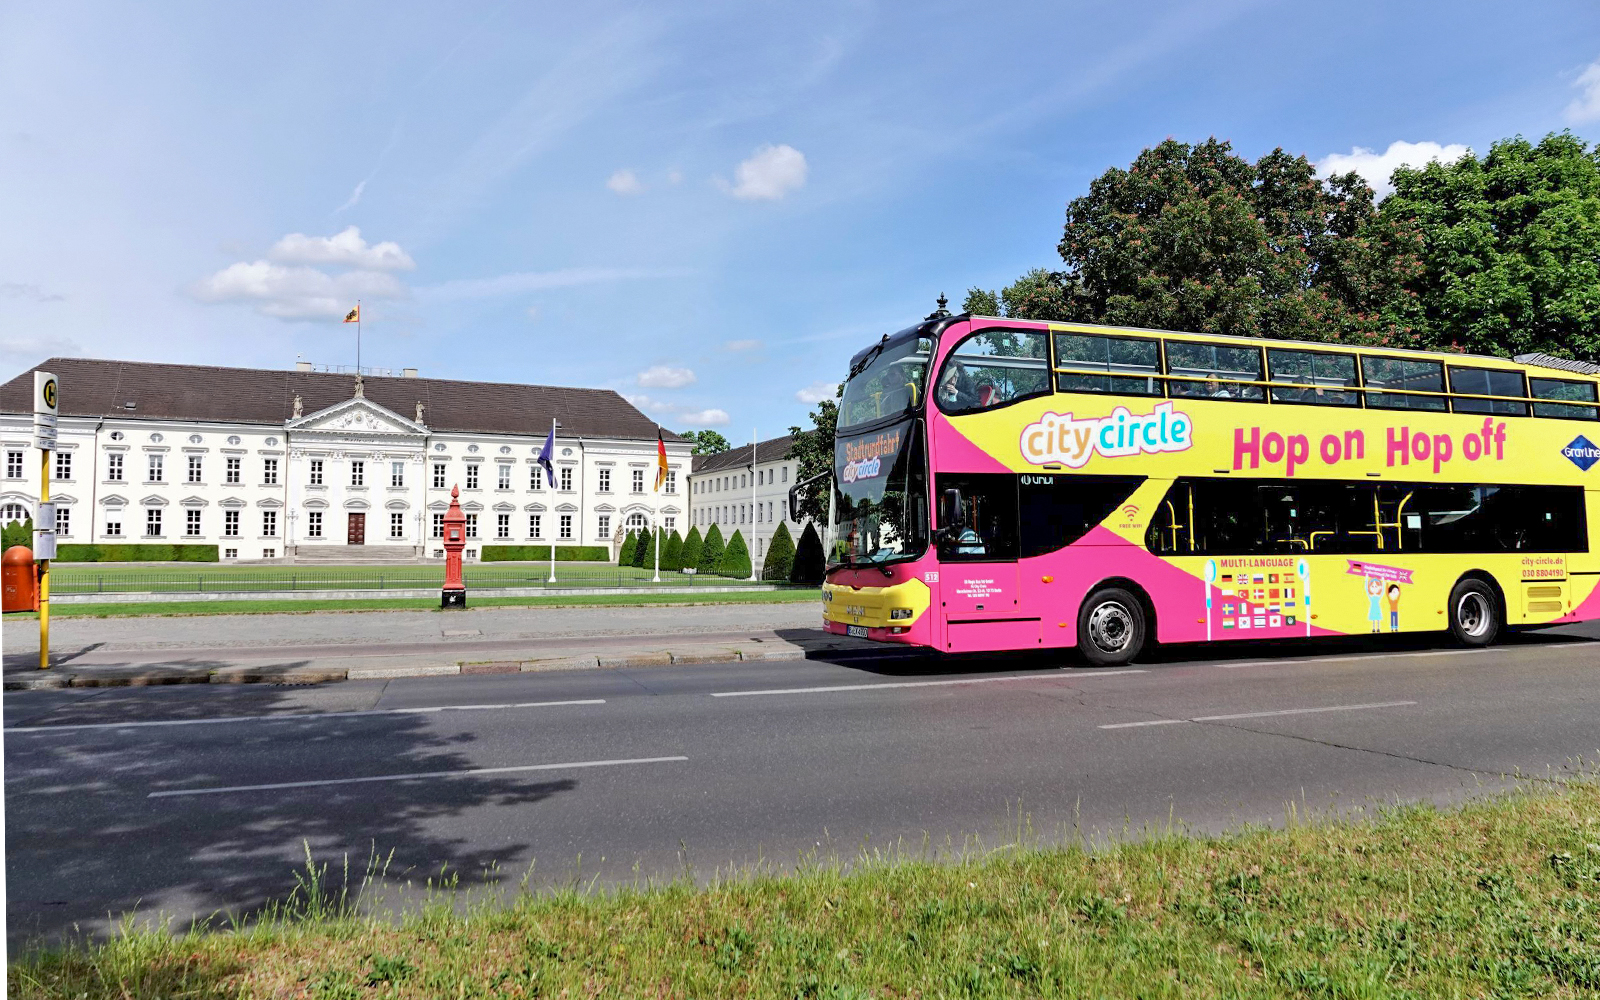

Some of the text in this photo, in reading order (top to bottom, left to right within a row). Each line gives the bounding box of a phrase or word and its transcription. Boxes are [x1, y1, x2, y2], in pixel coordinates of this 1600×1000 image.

[845, 430, 900, 462] Stadtrundfahrt
[1027, 412, 1186, 460] city circle
[1386, 417, 1507, 474] Hop off
[1233, 427, 1365, 477] Hop on
[844, 458, 880, 481] city circle
[1220, 558, 1294, 568] MULTI-LANGUAGE
[1521, 556, 1563, 568] city-circle.de
[1522, 569, 1564, 578] 030 8804190
